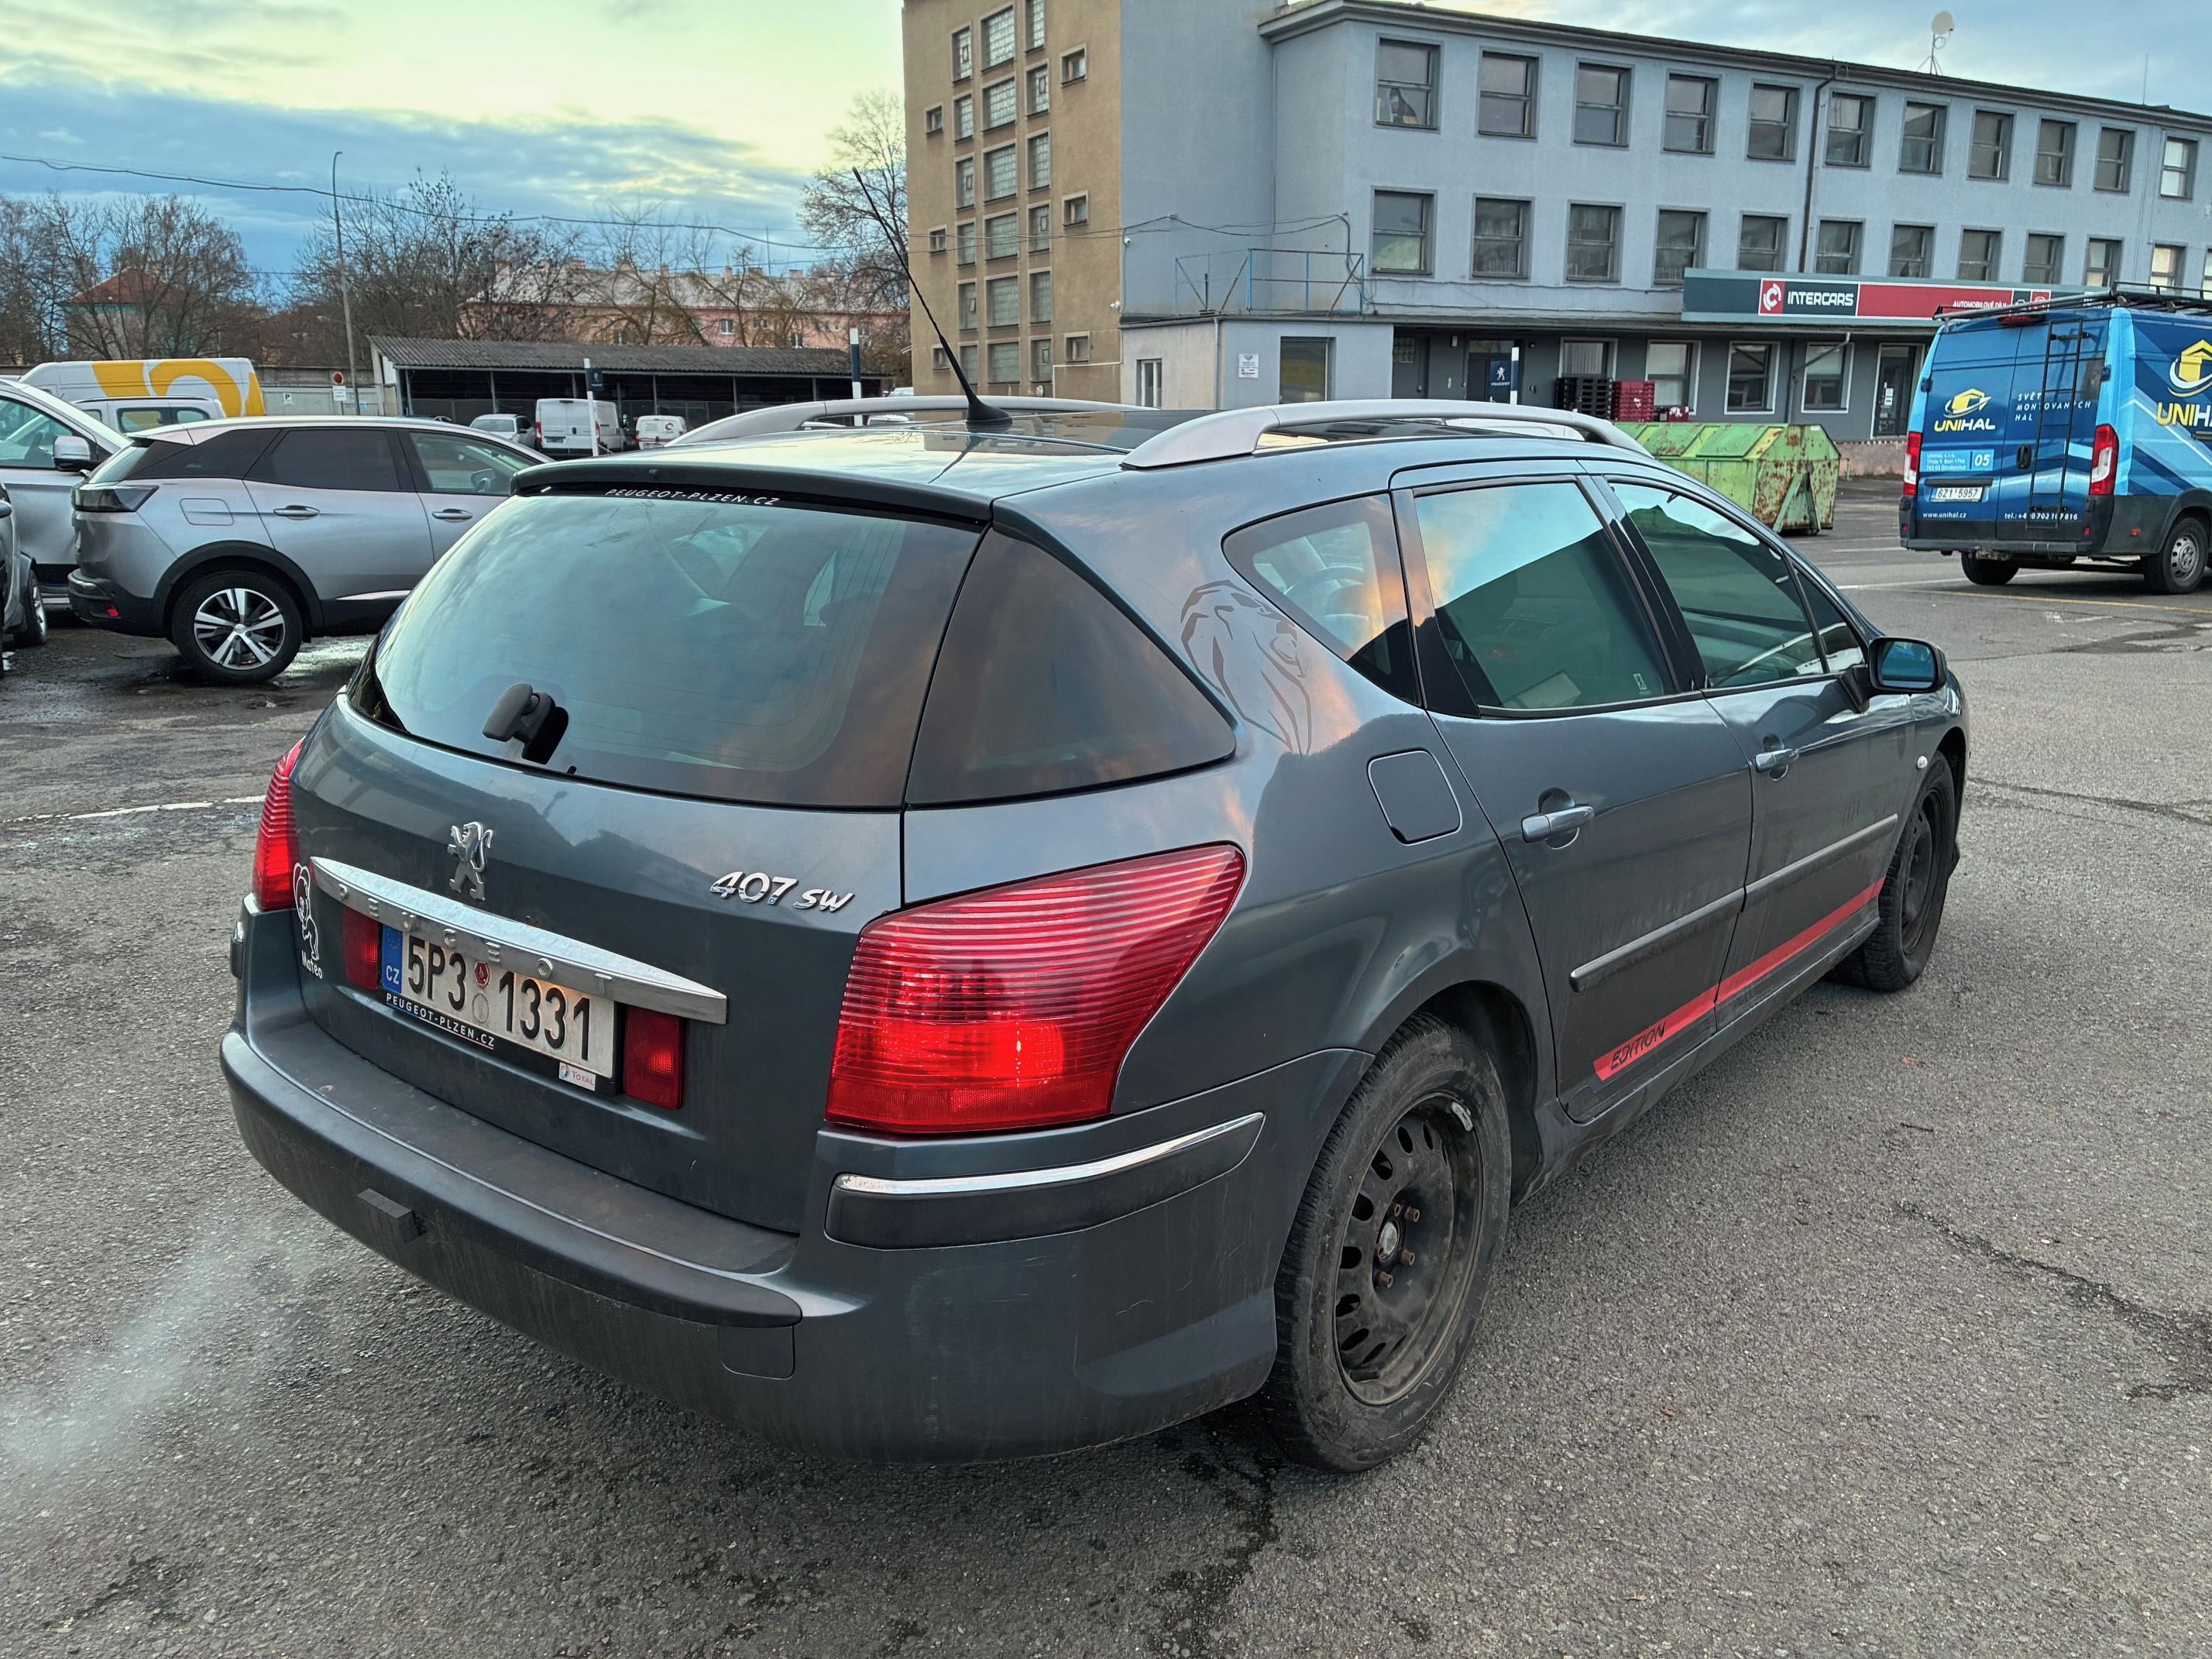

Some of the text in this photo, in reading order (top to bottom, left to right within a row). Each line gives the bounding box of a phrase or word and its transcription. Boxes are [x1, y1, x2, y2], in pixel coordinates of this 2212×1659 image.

[1788, 290, 1854, 307] INTERCARS
[2016, 400, 2091, 411] MONOVANCH
[2014, 414, 2033, 422] HAL
[2157, 402, 2212, 428] UNIH
[1934, 418, 1996, 432] UNIHAL
[1974, 454, 1991, 466] 05
[605, 489, 780, 506] PEUGEOT-PLZEN.CZ
[1938, 488, 1979, 498] 6Z1 5957
[710, 871, 855, 912] 407 SW
[301, 950, 323, 979] Mateo
[386, 965, 400, 985] CZ
[408, 936, 590, 1061] 5P3 1331
[386, 992, 495, 1047] PEUGEOT-PLZEN.CZ
[1611, 1022, 1666, 1070] EDITION
[572, 1070, 594, 1086] TOTAL
